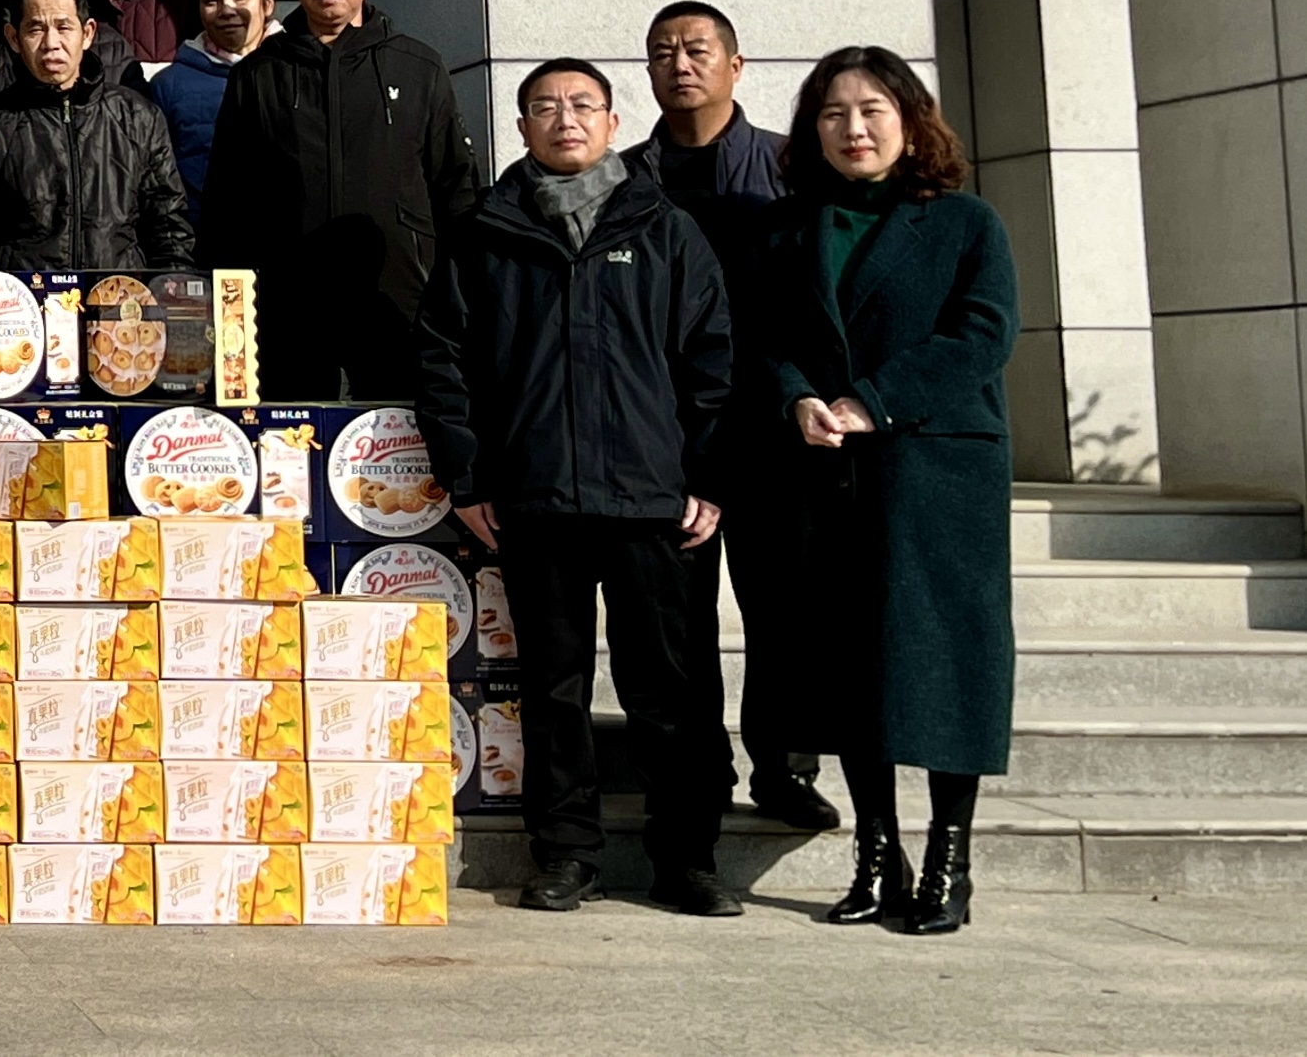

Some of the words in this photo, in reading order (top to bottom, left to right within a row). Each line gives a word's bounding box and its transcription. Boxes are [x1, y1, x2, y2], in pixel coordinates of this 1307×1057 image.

[350, 434, 425, 461] Danma
[146, 464, 187, 475] BUTTER
[189, 464, 236, 475] COOKIES
[351, 465, 392, 474] BUTTER
[394, 465, 431, 474] COOKI
